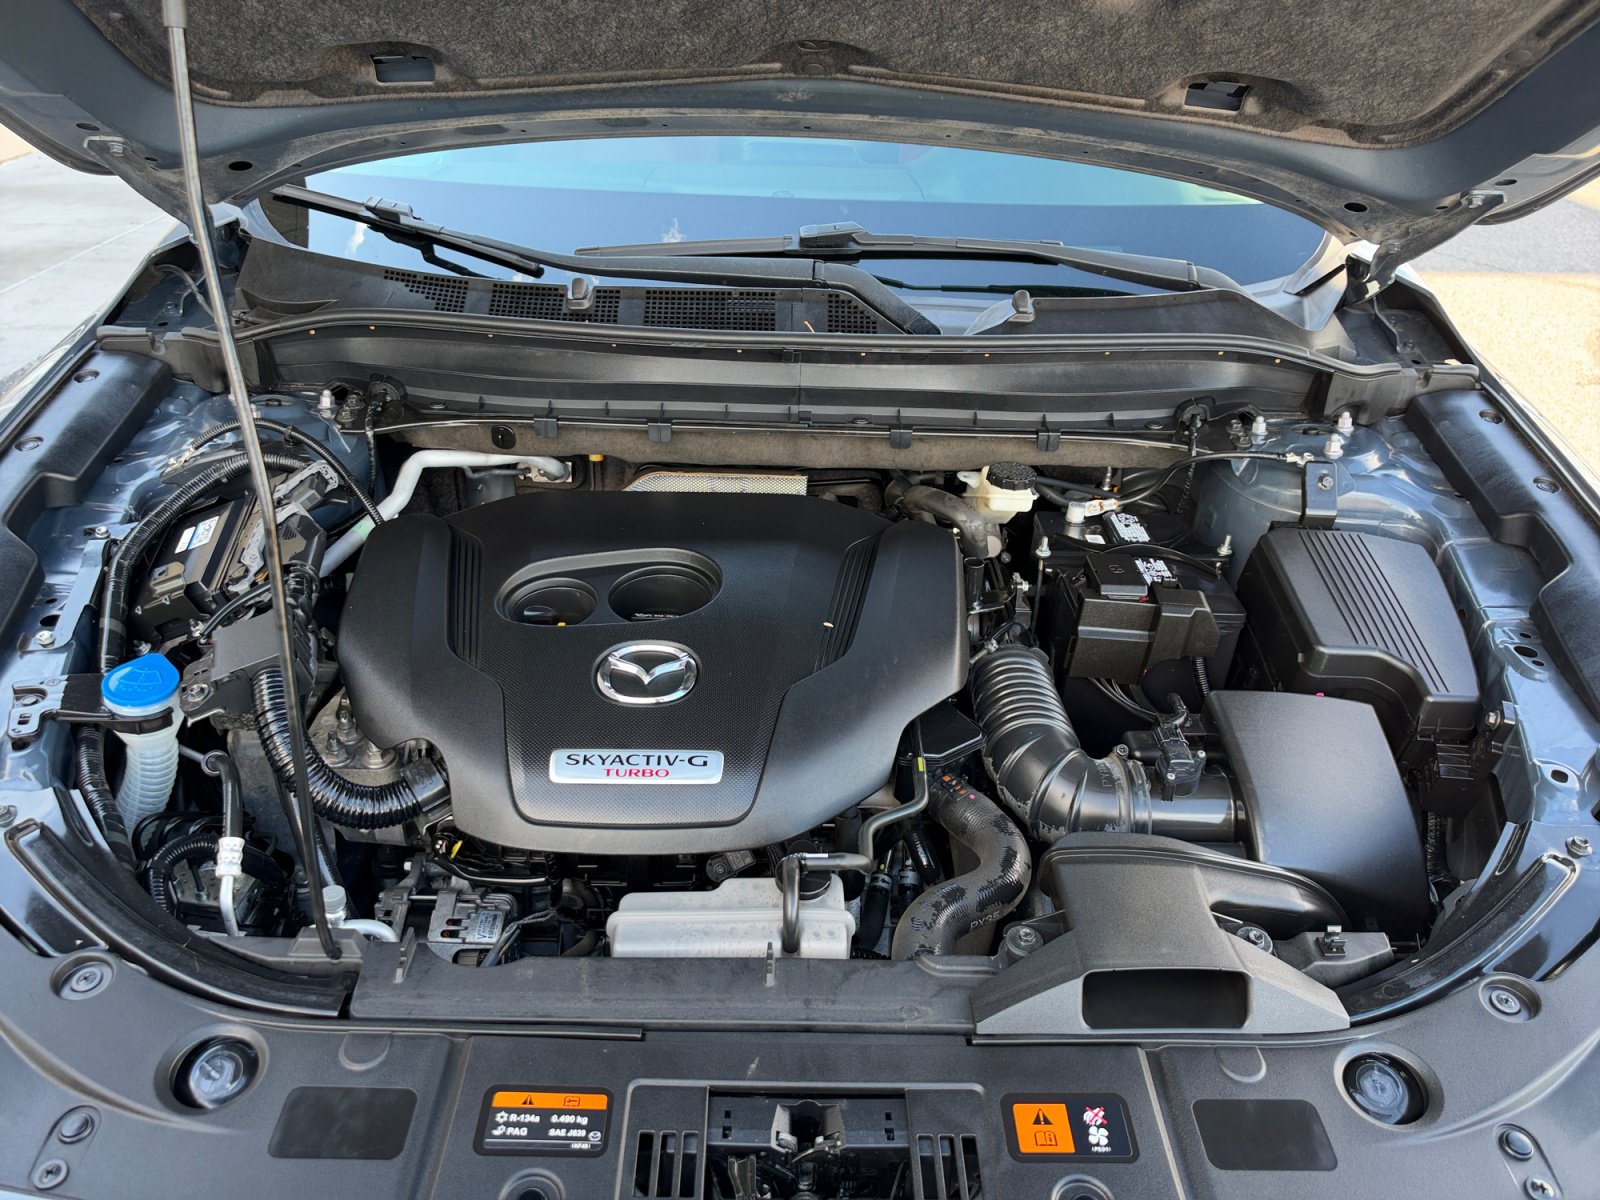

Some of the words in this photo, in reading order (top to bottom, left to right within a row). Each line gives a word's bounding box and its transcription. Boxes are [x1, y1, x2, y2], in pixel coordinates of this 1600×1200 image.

[565, 753, 709, 767] SKYACTIV-G
[603, 768, 670, 778] TURBO
[508, 1113, 541, 1123] R-134a
[576, 1115, 588, 1125] kg
[505, 1126, 528, 1136] PAG
[548, 1128, 566, 1137] SAE
